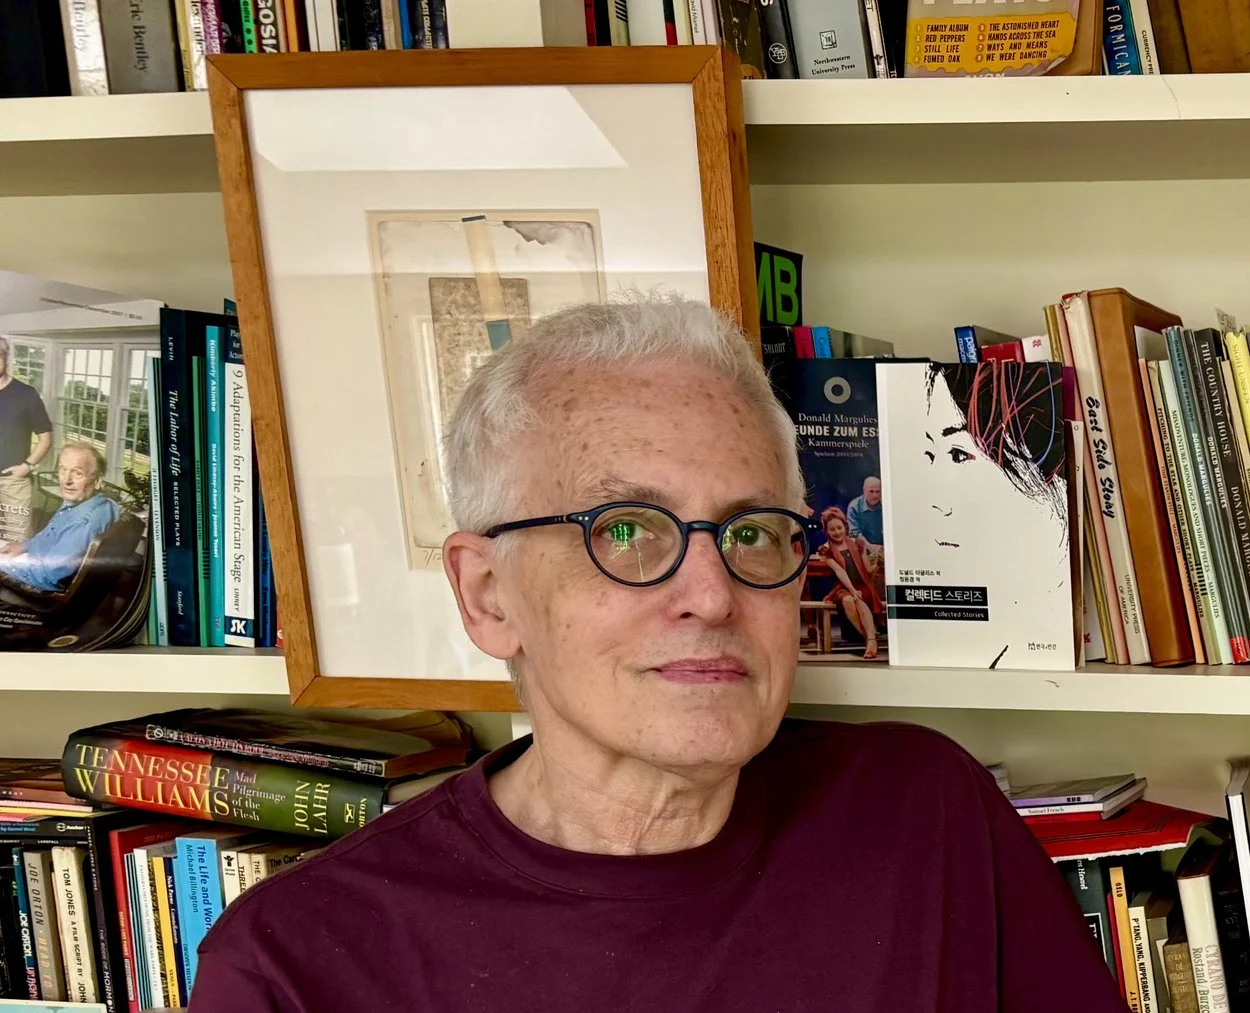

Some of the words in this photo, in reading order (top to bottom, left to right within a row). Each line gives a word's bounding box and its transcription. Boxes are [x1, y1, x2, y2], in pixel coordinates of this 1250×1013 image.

[927, 24, 947, 32] FAMILY
[949, 24, 969, 32] ALBUM
[812, 66, 839, 75] University
[814, 56, 850, 65] Northwestern
[1201, 341, 1212, 363] THE
[233, 370, 243, 378] 9
[169, 390, 178, 408] The
[1206, 366, 1223, 417] COUNTRY
[233, 379, 243, 454] Adaptations
[1086, 396, 1103, 432] East
[170, 410, 178, 442] Labor
[170, 444, 179, 455] of
[808, 438, 869, 449] Kammerspiele
[1217, 421, 1231, 458] HOUSE
[233, 457, 242, 471] for
[1093, 439, 1112, 470] Side
[170, 456, 179, 476] Life
[233, 474, 241, 490] the
[1100, 477, 1115, 518] Story
[233, 493, 242, 549] American
[231, 551, 242, 583] Stage
[905, 589, 943, 602] 컬렉티드
[945, 590, 983, 602] 스토리즈
[934, 610, 961, 618] Collected
[75, 743, 230, 790] TENNESSEE
[234, 771, 257, 784] Mad
[73, 768, 230, 816] WILLIAMS
[233, 784, 286, 804] Pilgrimage
[232, 798, 242, 806] of
[245, 799, 261, 810] the
[294, 780, 311, 830] JOHN
[313, 782, 331, 834] LAHR
[233, 808, 260, 822] Flesh
[62, 868, 71, 888] TOM
[65, 890, 76, 916] JONES
